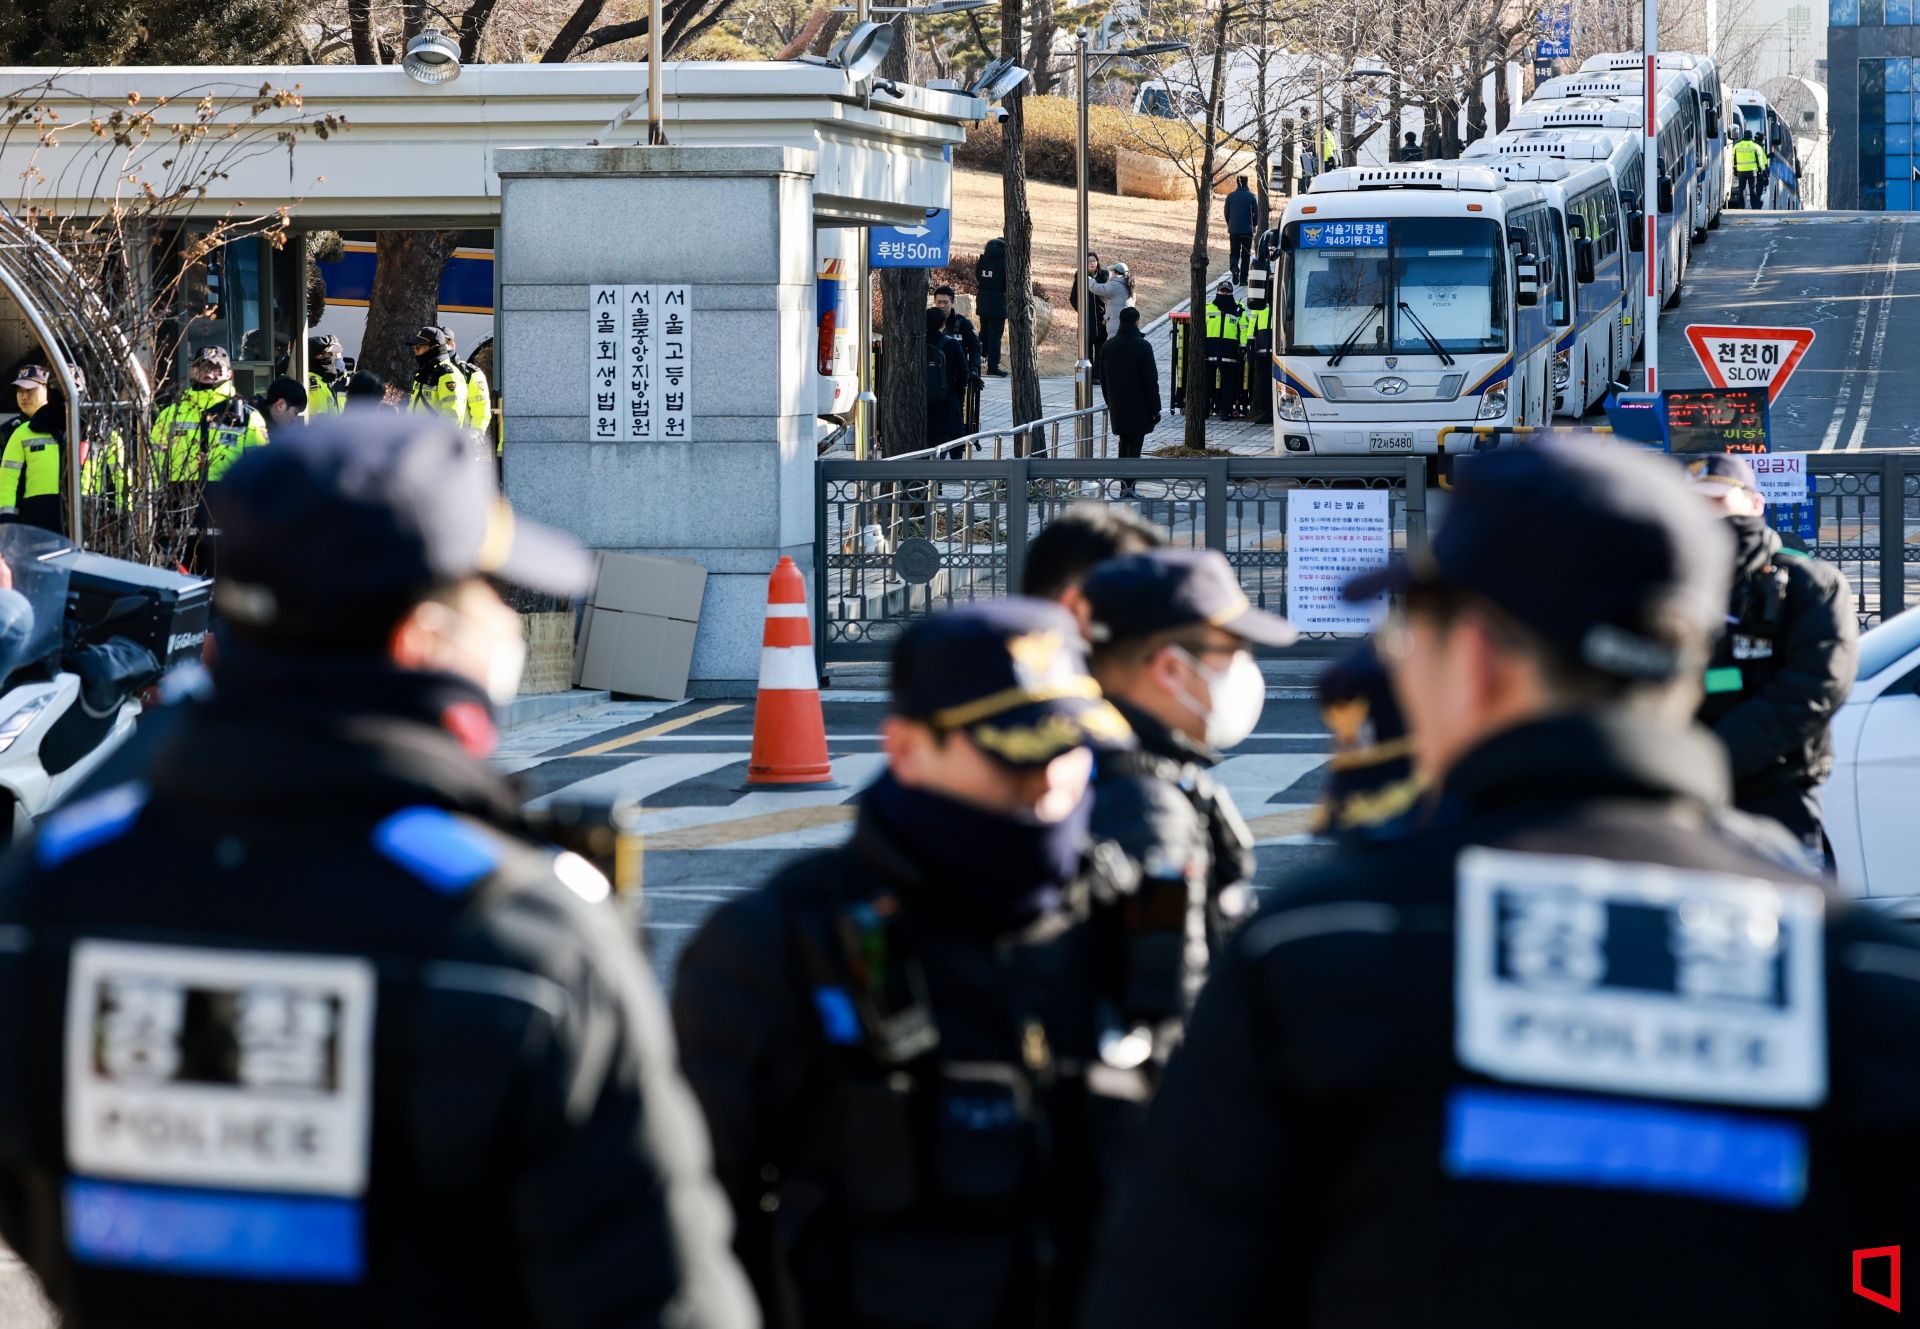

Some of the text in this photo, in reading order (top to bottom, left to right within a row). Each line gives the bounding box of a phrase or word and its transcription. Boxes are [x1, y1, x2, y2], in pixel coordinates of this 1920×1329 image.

[1325, 223, 1385, 235] 서울기동경찰
[596, 289, 616, 437] 서울회생법원
[631, 289, 650, 436] 서울중앙지방법원
[665, 289, 684, 437] 서울고등법원
[1718, 343, 1778, 365] 천천히
[1728, 367, 1771, 381] SLOW
